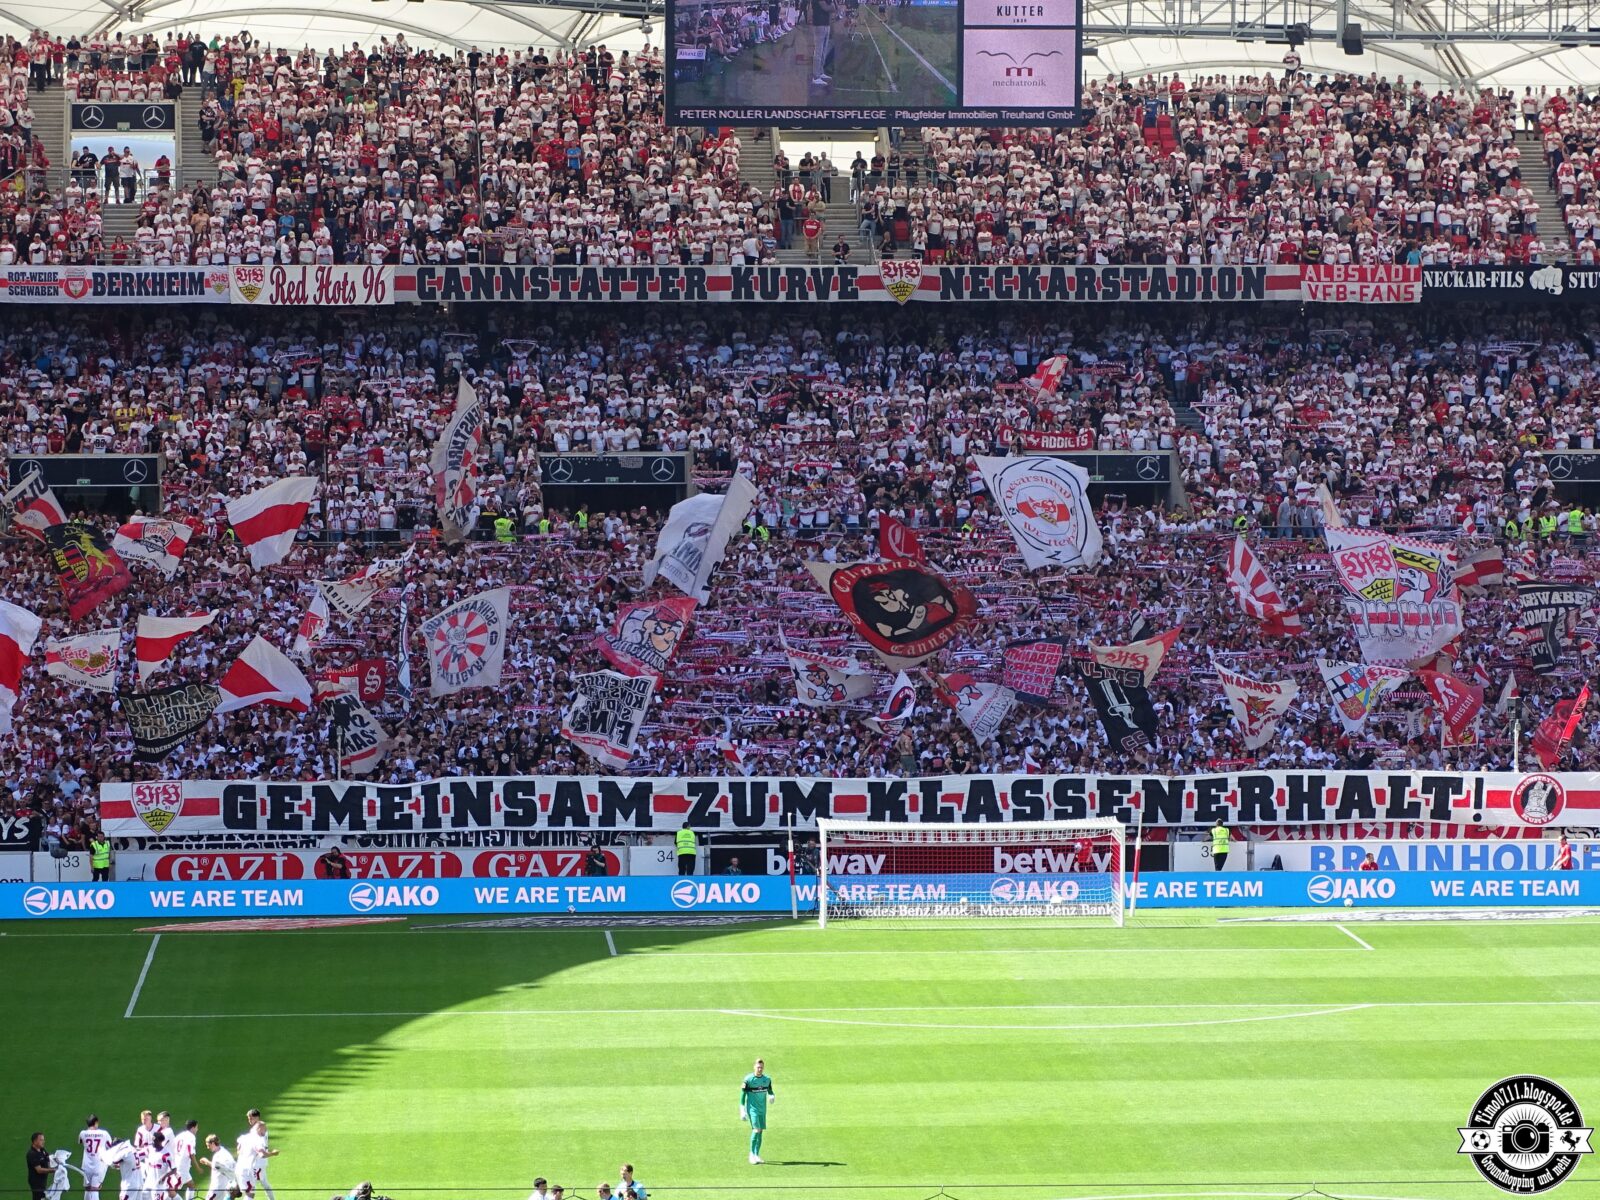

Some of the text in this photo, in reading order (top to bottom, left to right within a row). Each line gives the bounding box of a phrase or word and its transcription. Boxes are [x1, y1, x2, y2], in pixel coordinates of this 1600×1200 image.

[996, 5, 1044, 17] KUTTER
[992, 79, 1047, 87] mechatronik
[680, 109, 716, 119] PETER
[719, 109, 762, 119] NOLLER
[764, 109, 886, 119] LANDSCHAFTSPFLEGE
[895, 110, 946, 121] Pflugfelder
[948, 110, 998, 120] Immobilien
[1001, 110, 1044, 120] Treuhand
[1305, 264, 1420, 282] ALBSTADT
[1423, 271, 1600, 289] NECKAR-FILS STU
[8, 285, 59, 297] SCHWABEN
[92, 272, 205, 297] BERKHEIM
[269, 265, 386, 305] Red Hots 96
[416, 266, 859, 301] CANNSTATTER KURVE
[939, 266, 1267, 301] NECKARSTADION
[1308, 283, 1416, 302] VFB-FANS
[1041, 433, 1088, 449] ADDICTS
[134, 783, 181, 807] VfB
[222, 774, 1485, 832] GEMEINSAM ZUM KLASSENERHALT!
[62, 855, 80, 868] 33
[657, 850, 675, 863] 34
[993, 847, 1112, 873] betwy
[376, 885, 440, 907] JAKO
[474, 886, 625, 904] WE ARE TEAM
[697, 882, 761, 904] JAKO
[834, 884, 881, 901] ARE
[887, 883, 946, 901] TEAM
[1017, 880, 1080, 901] JAKO
[1153, 881, 1198, 898] ARE
[1203, 880, 1263, 898] TEAM
[1333, 878, 1396, 899] JAKO
[1430, 879, 1580, 897] WE ARE TEAM
[51, 888, 115, 911] JAKO
[150, 889, 303, 907] WE ARE TEAM
[832, 905, 932, 917] Mercedes-Benz
[980, 904, 1114, 917] Mercedes-Benz Bank
[86, 1138, 102, 1154] 37
